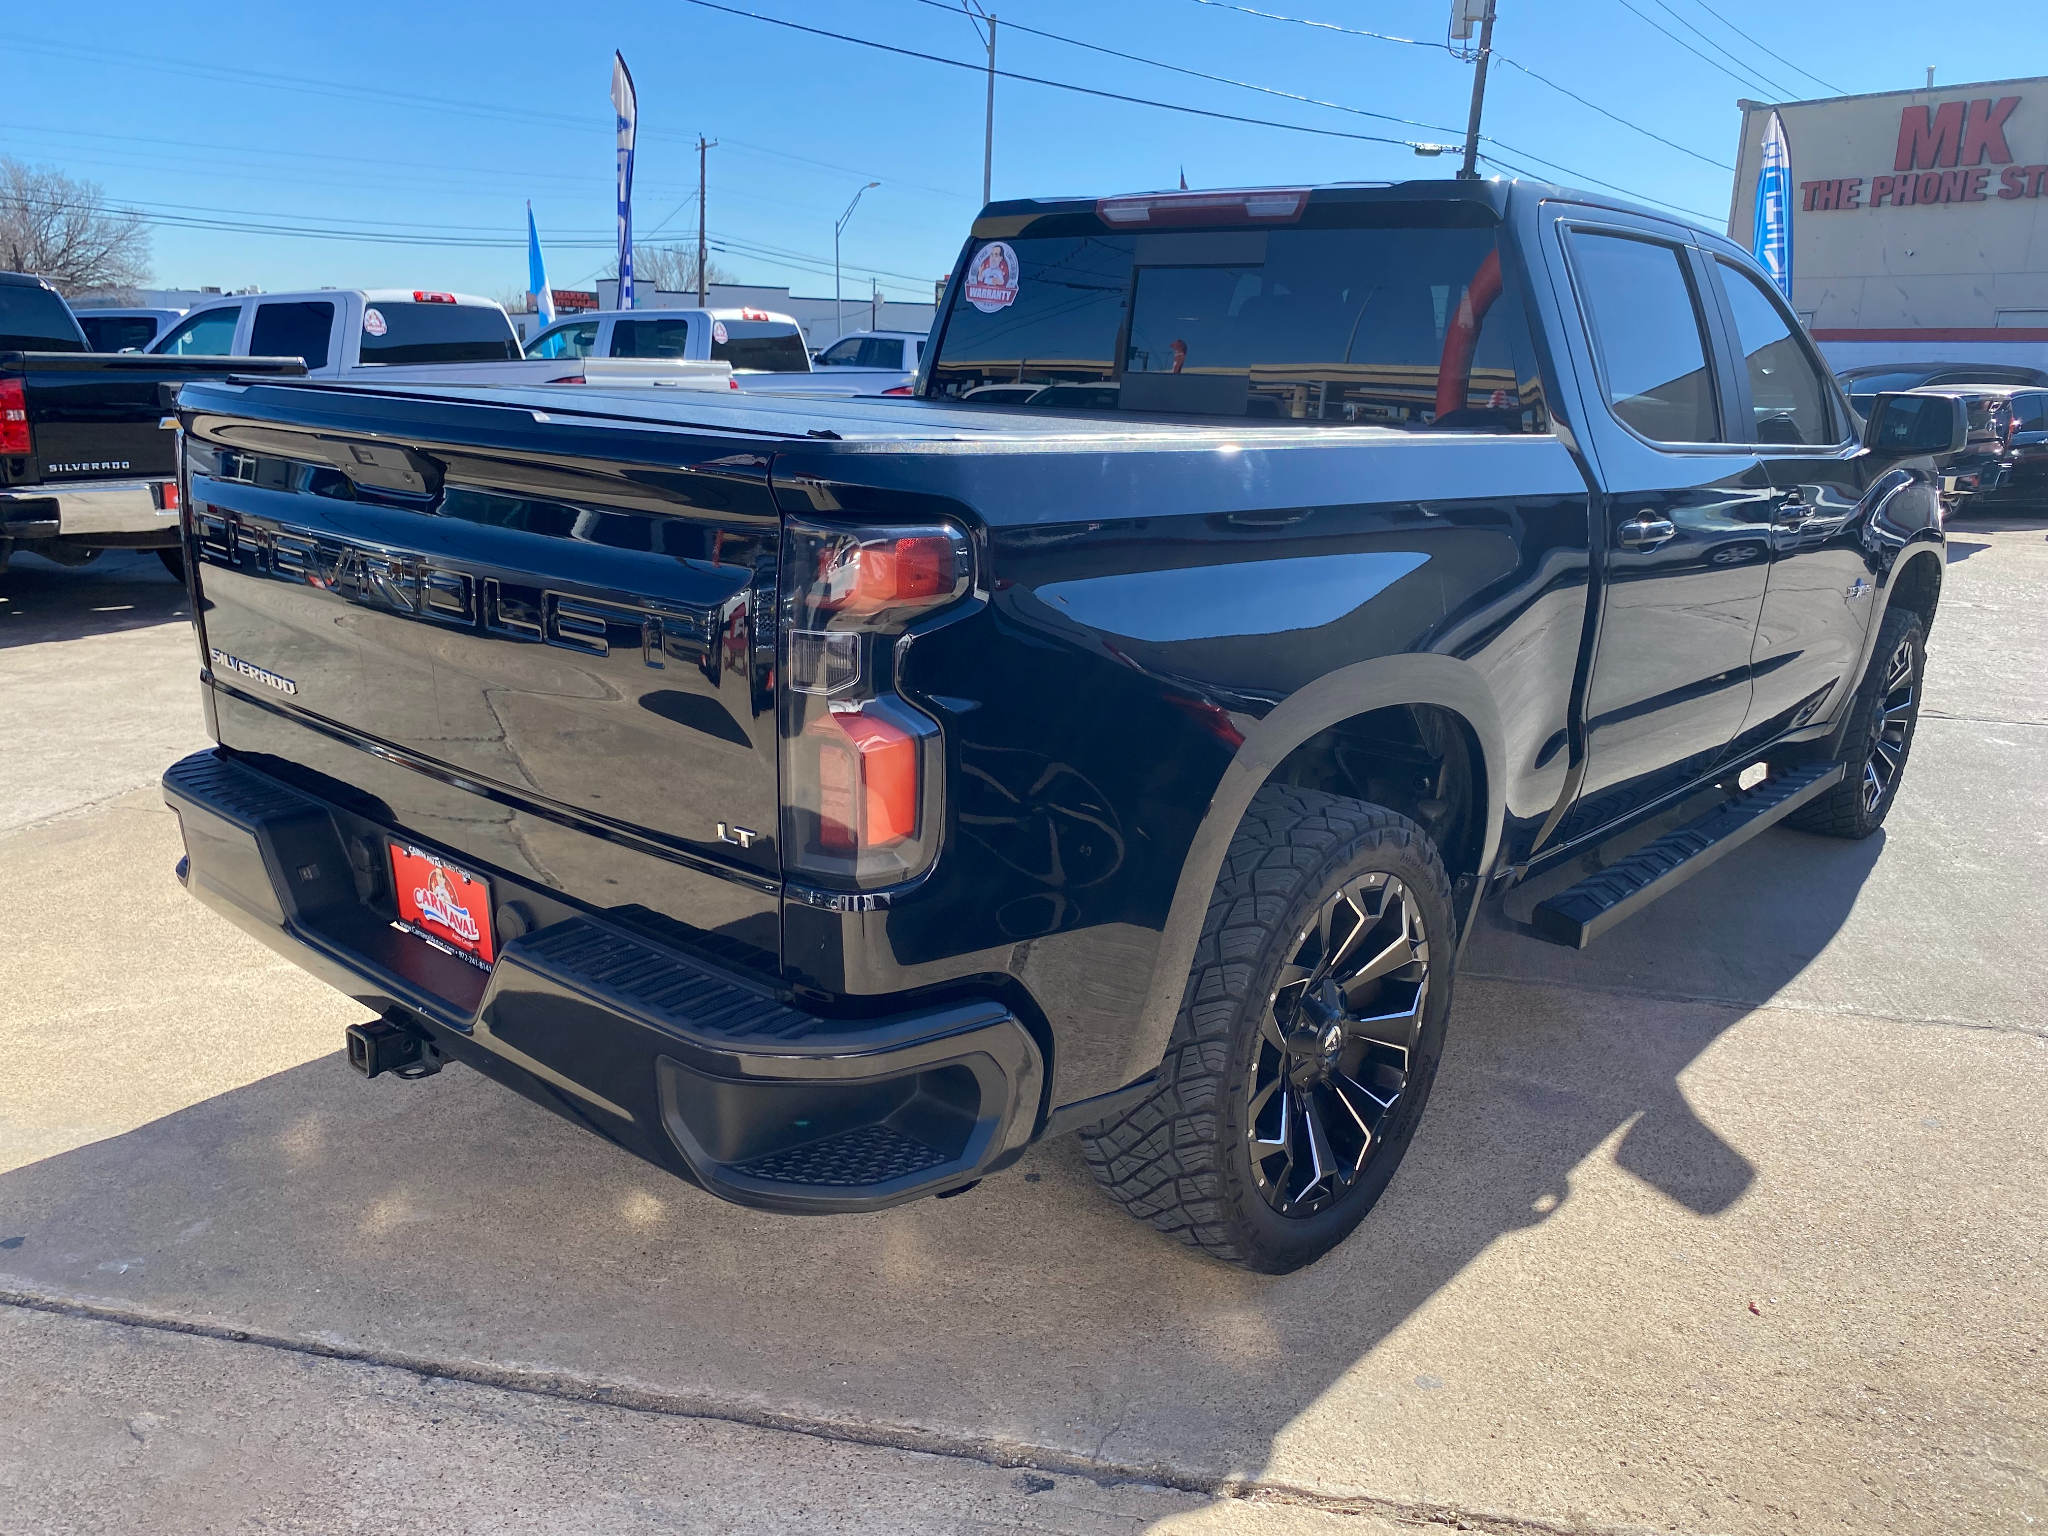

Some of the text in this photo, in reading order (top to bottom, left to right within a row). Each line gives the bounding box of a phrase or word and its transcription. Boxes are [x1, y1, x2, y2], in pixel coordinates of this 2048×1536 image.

[1894, 96, 2022, 171] MK
[1800, 178, 1862, 211] THE
[1869, 168, 1991, 207] PHONE
[555, 291, 590, 300] MAKKA
[969, 287, 1011, 301] WARRANTY
[48, 461, 130, 472] SILVERADO
[198, 511, 694, 669] CHEVROLET
[210, 647, 298, 695] SILVERADO
[717, 821, 757, 848] LT
[414, 889, 478, 936] CARNAVAL
